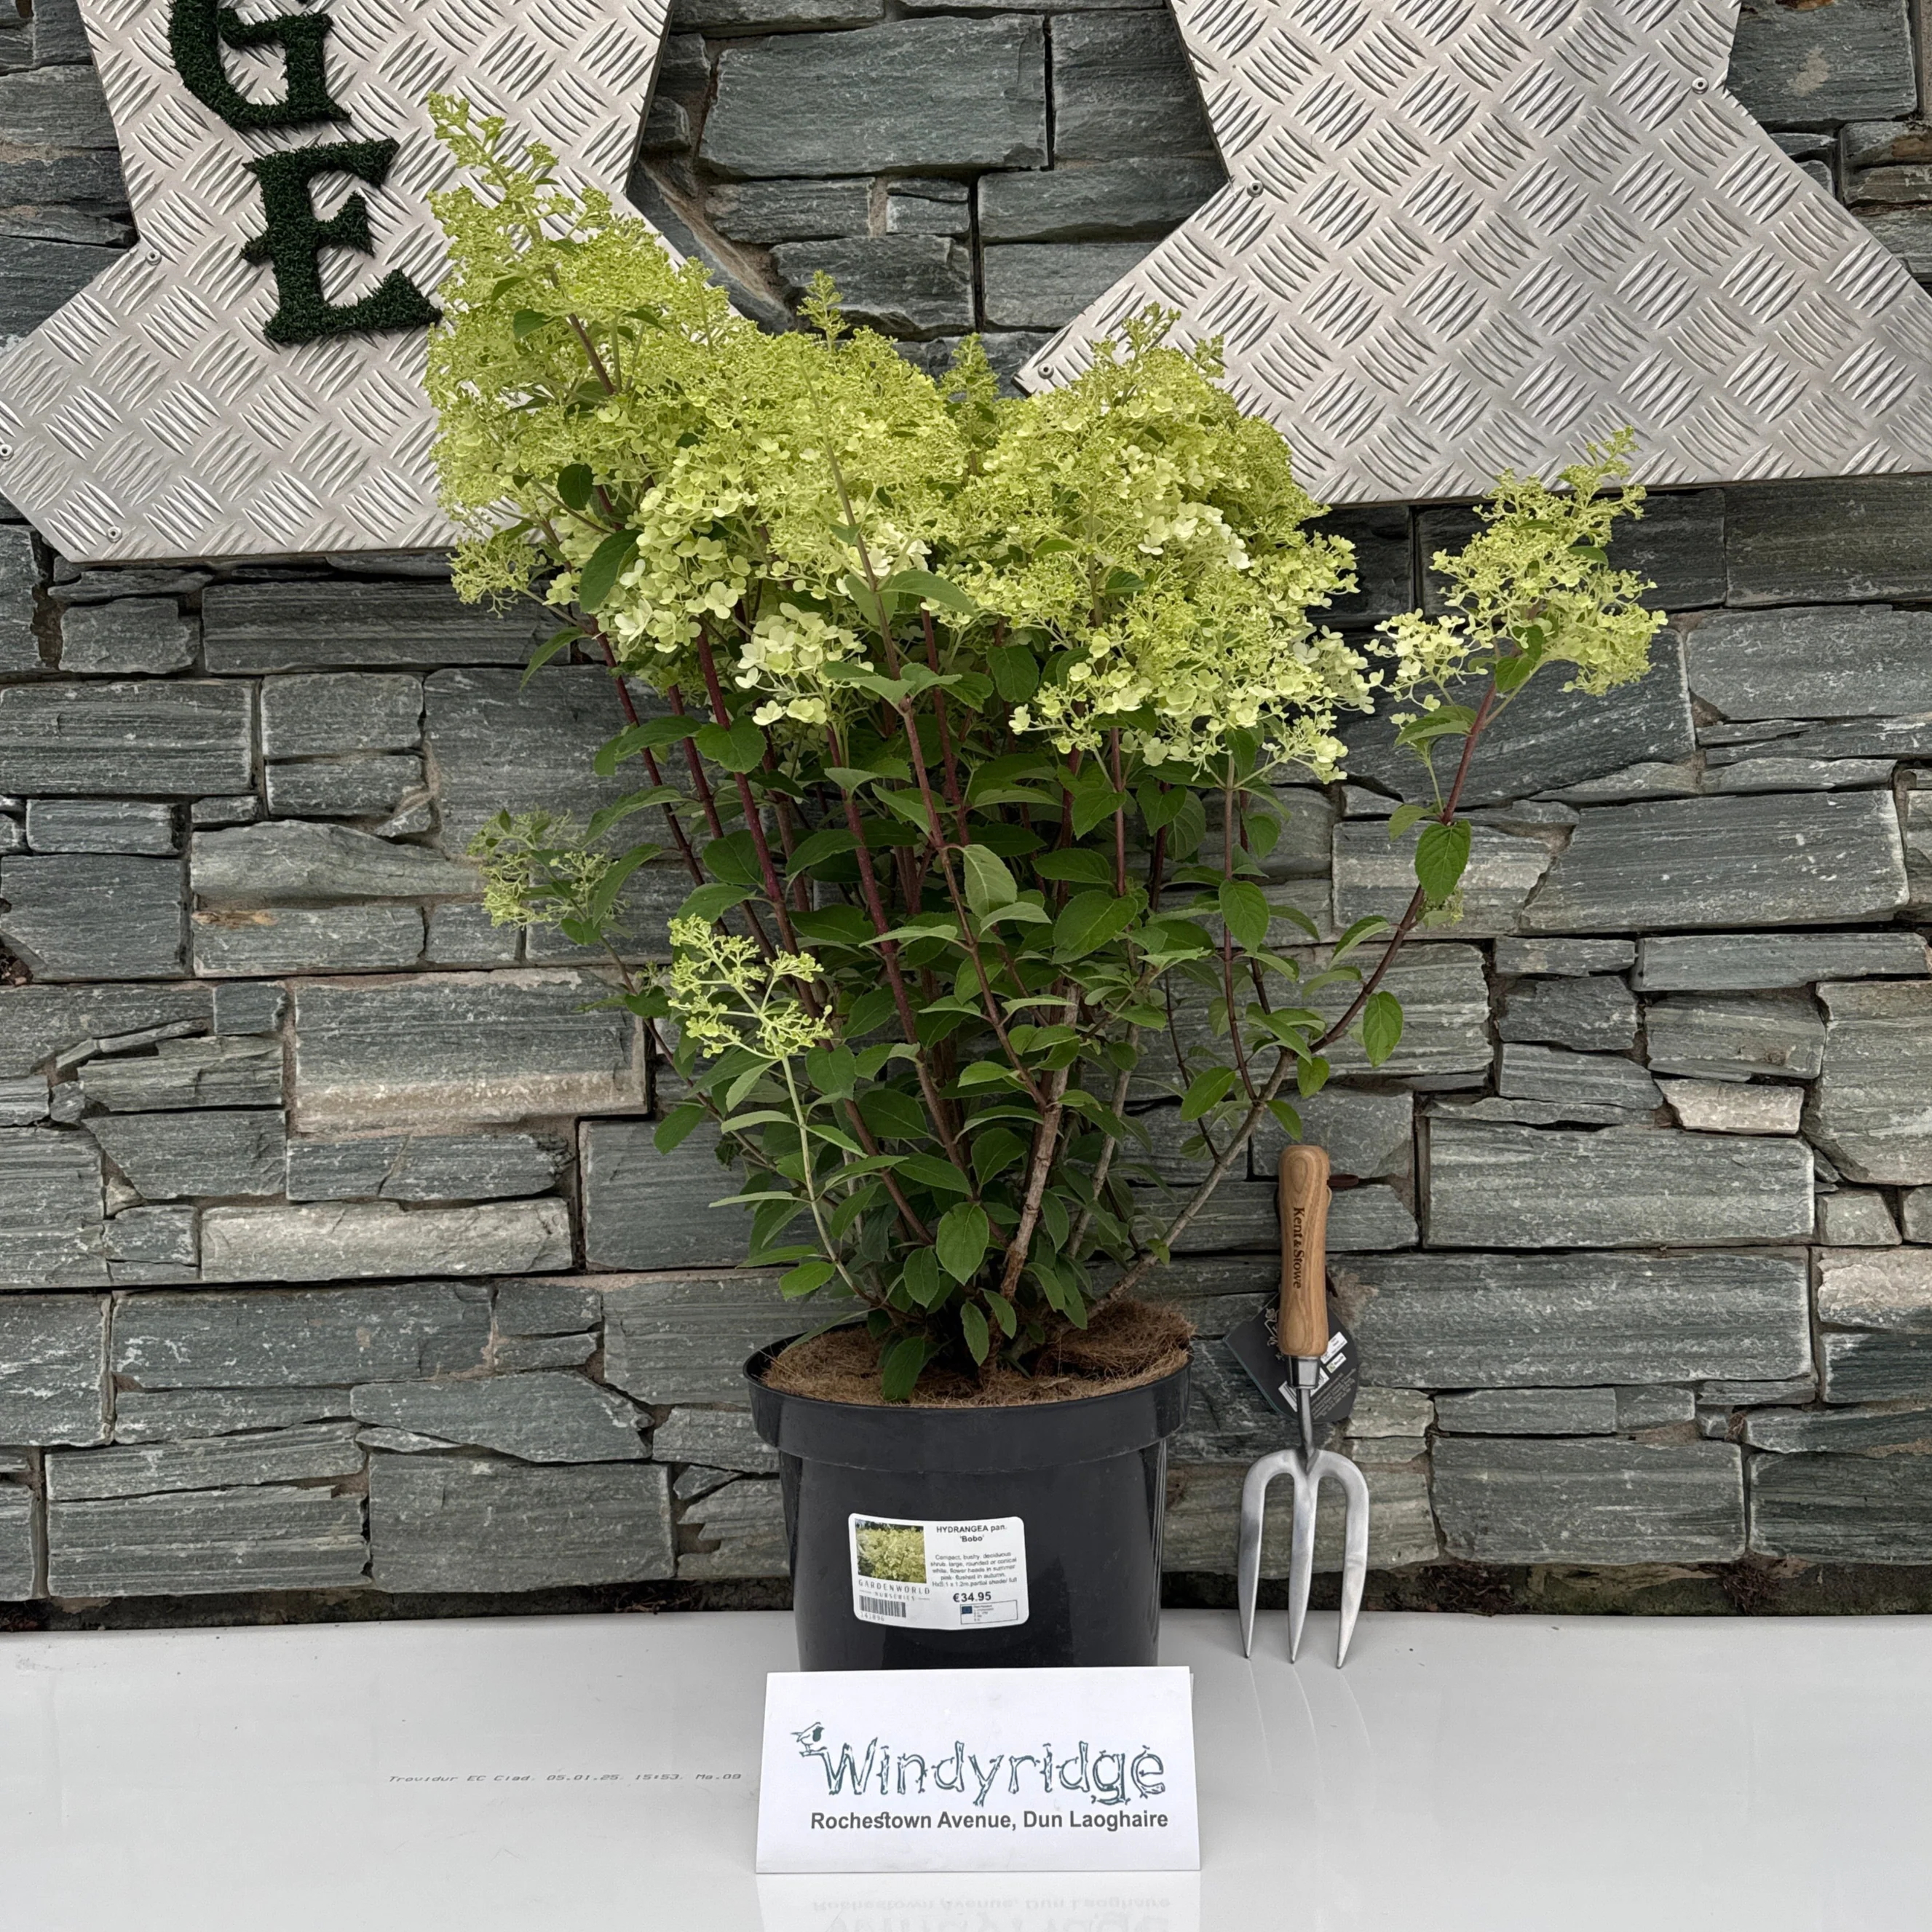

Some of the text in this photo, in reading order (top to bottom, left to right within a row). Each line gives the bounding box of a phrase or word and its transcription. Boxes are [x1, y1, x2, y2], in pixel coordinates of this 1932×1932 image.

[1293, 1207, 1305, 1289] Kent & Stowe
[936, 1524, 1007, 1533] HYDRANGEA pan.
[959, 1535, 984, 1543] 'Bobo'
[858, 1579, 930, 1595] GARDENWORLD
[953, 1591, 992, 1602] €34.95
[801, 1736, 1166, 1807] Windyridge
[810, 1809, 1169, 1832] Rochestown Avenue, Dun Laoghaire
